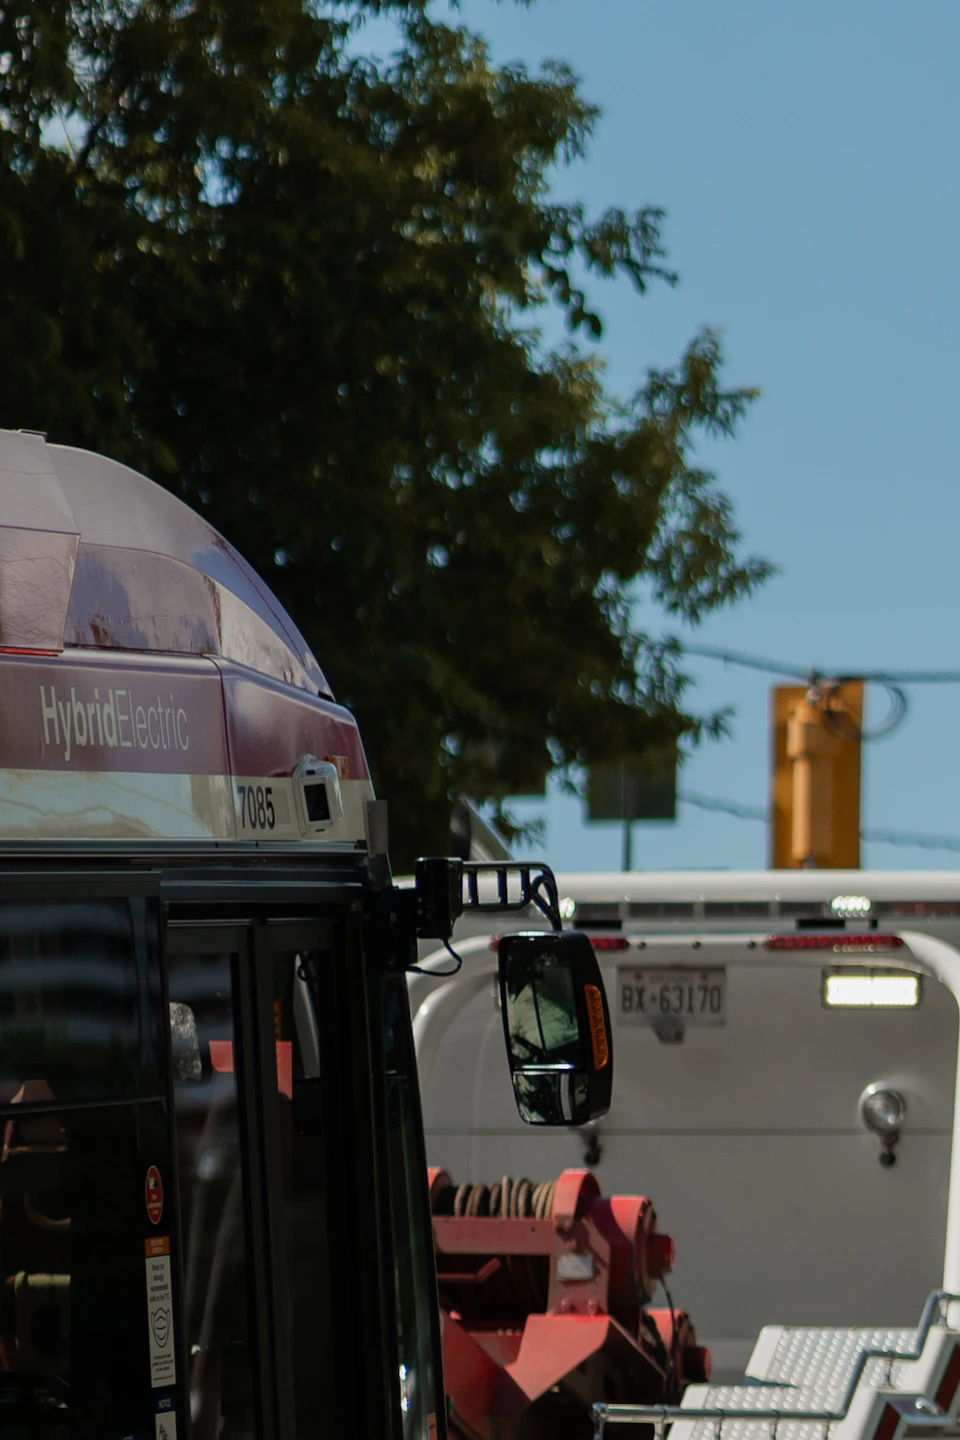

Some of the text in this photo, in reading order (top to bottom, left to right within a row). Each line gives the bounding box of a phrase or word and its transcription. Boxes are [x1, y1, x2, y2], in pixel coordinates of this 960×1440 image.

[39, 684, 190, 762] HybridElectric
[236, 785, 276, 830] 7085
[658, 983, 723, 1014] 63170
